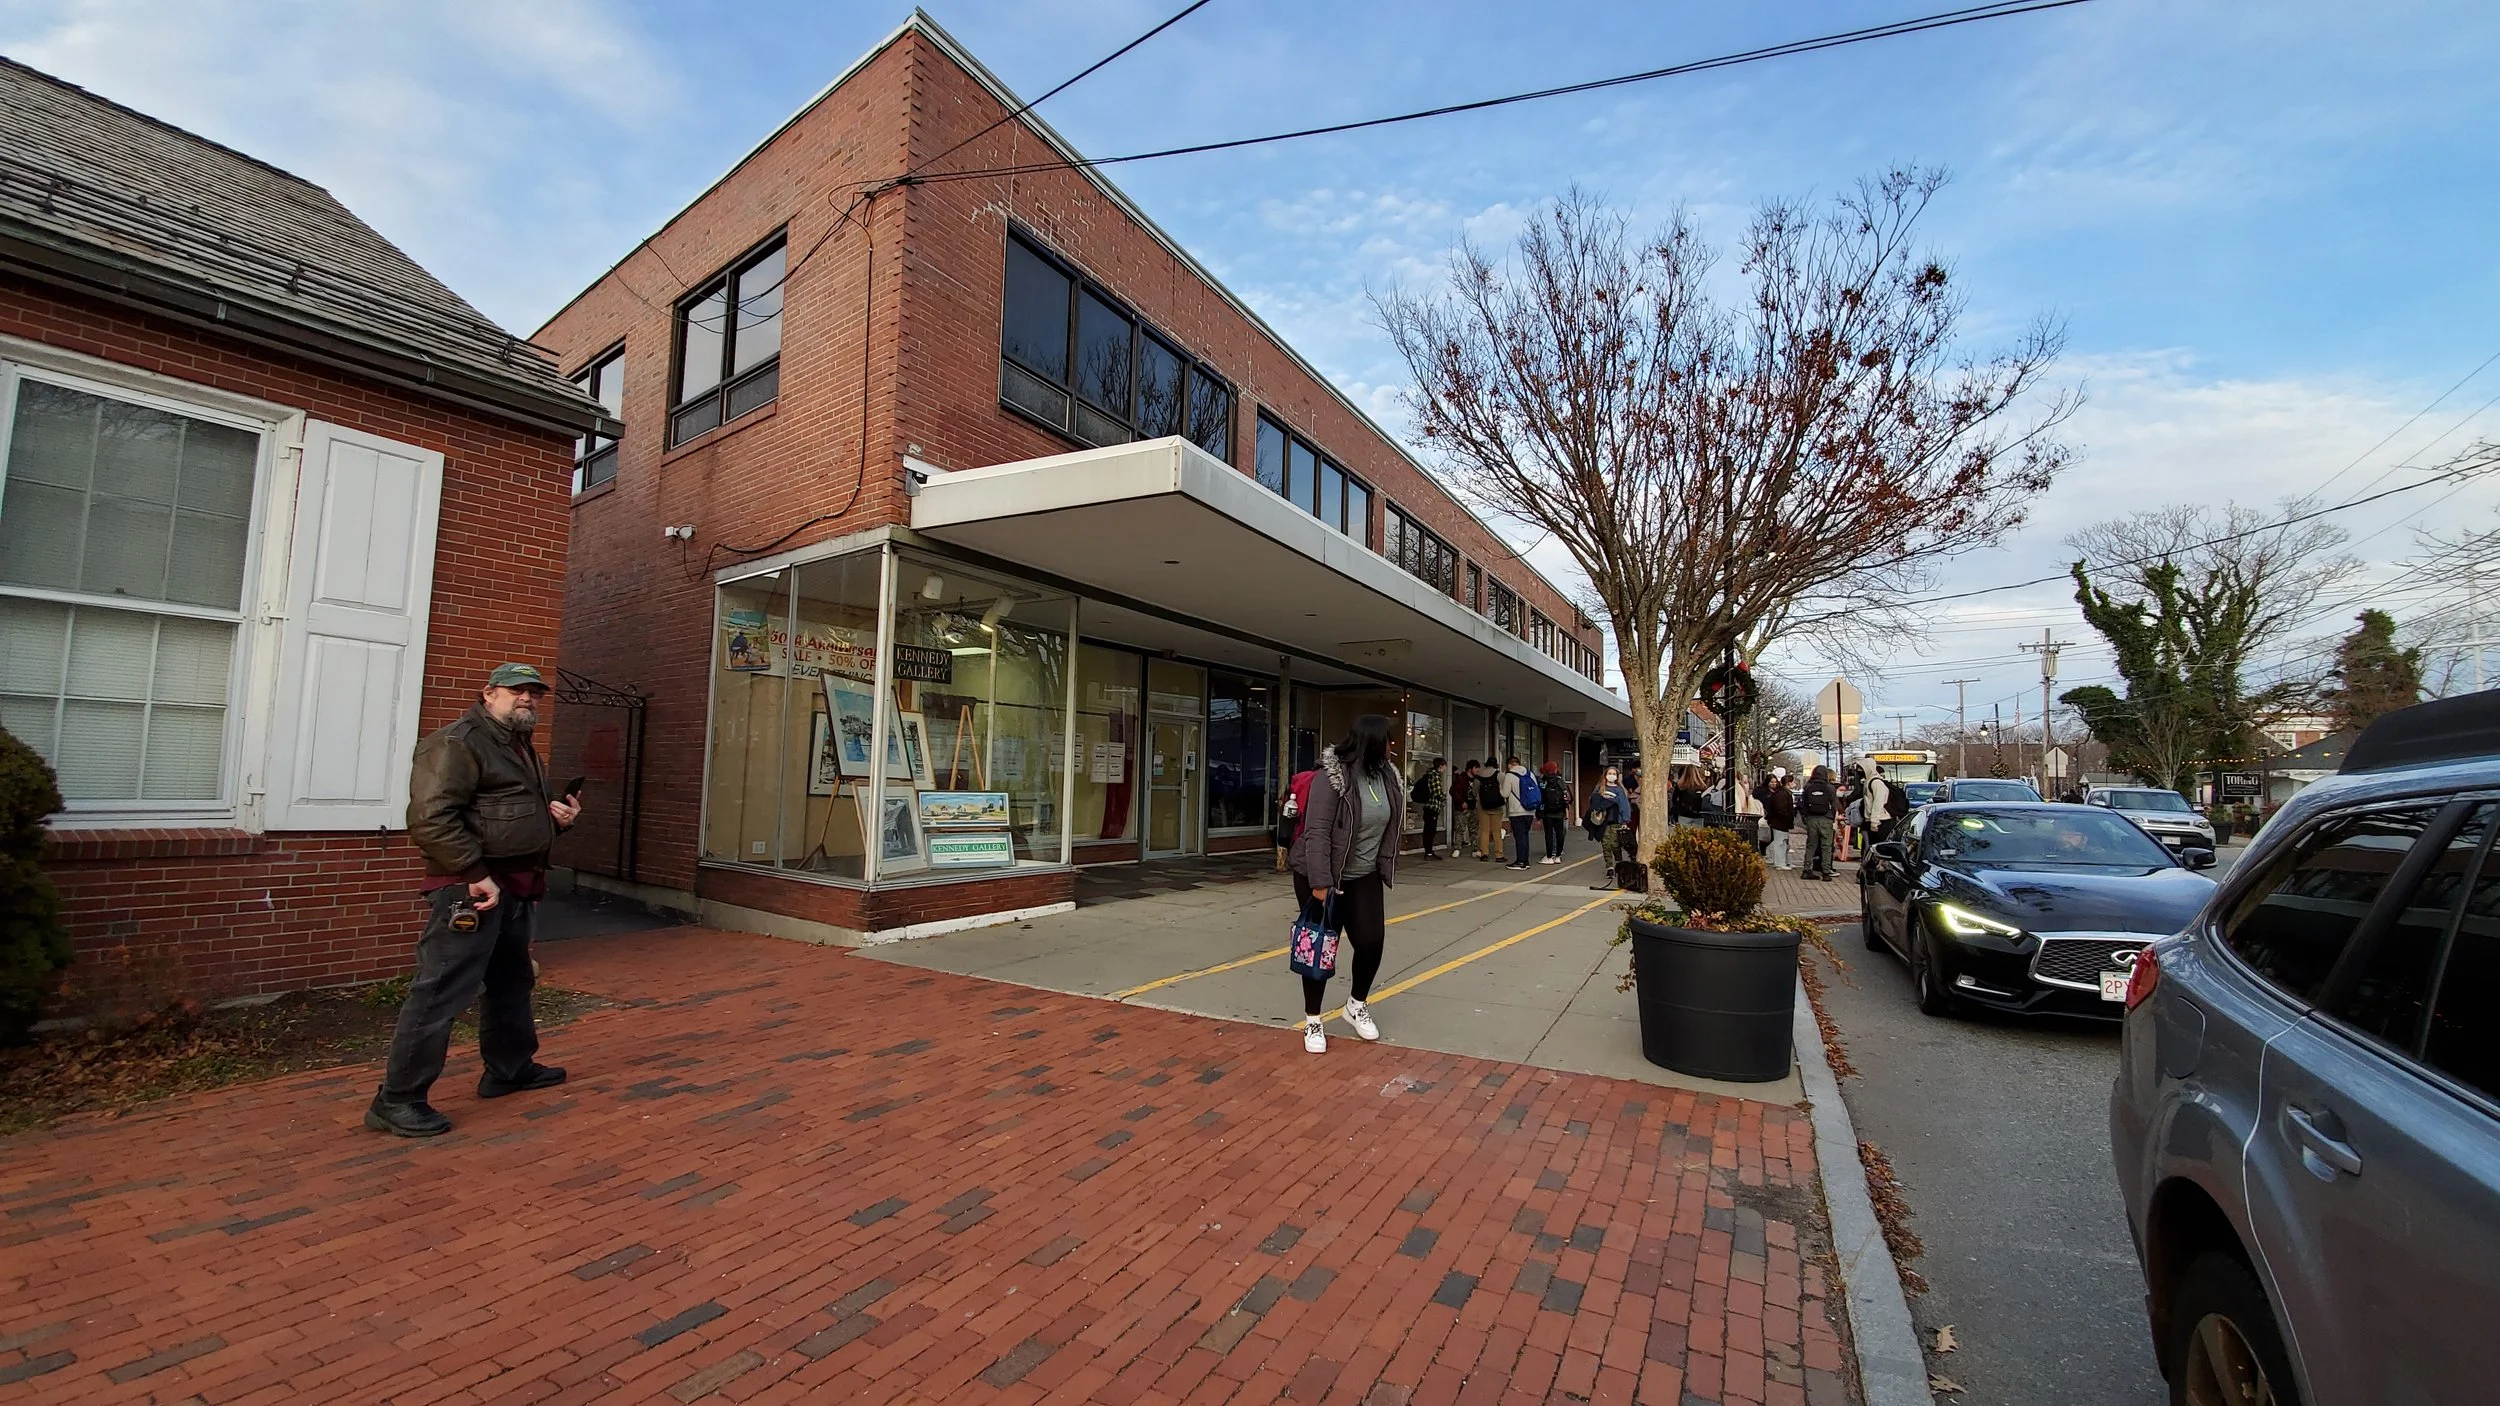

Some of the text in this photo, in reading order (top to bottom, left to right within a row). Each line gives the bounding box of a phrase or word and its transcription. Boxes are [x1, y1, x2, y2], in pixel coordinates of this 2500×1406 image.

[828, 655, 856, 669] 50%
[859, 658, 877, 671] OF
[896, 647, 950, 665] KENNEDY
[897, 662, 948, 680] GALLERY
[932, 843, 1006, 853] KENNEDY GALLERY
